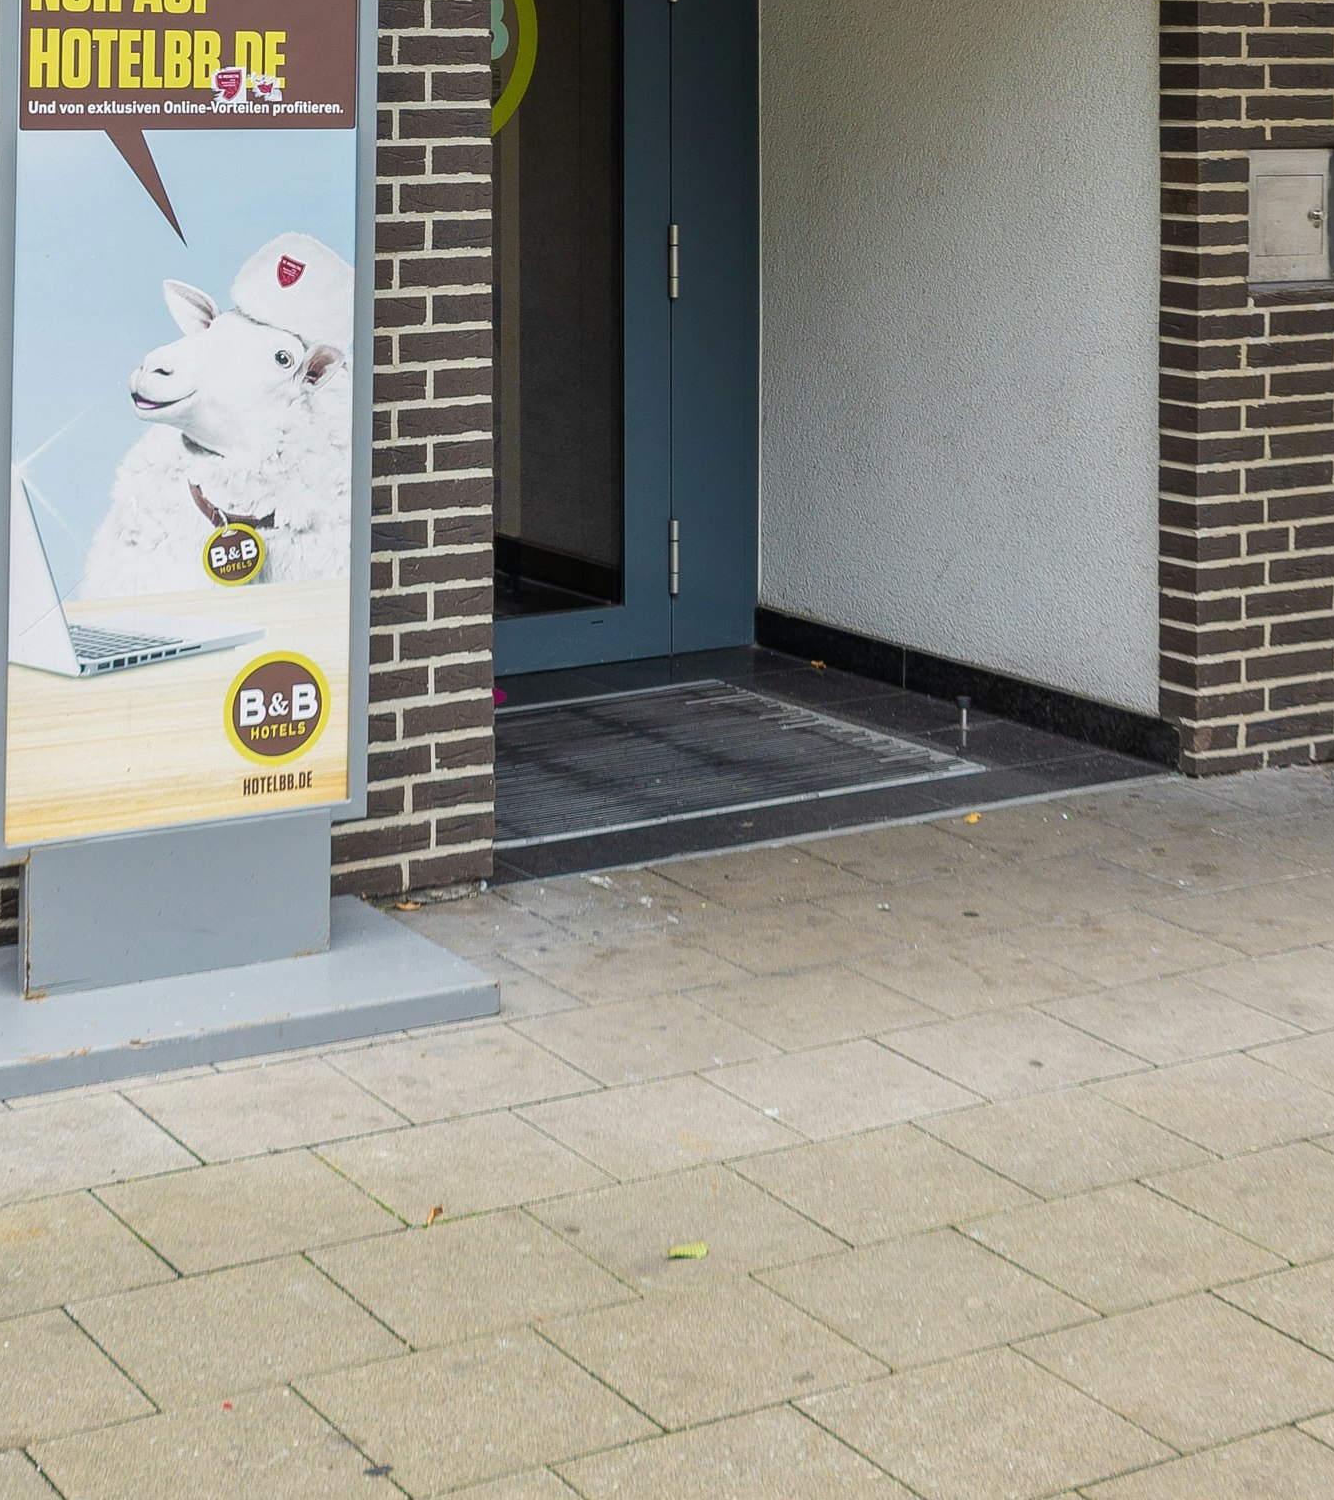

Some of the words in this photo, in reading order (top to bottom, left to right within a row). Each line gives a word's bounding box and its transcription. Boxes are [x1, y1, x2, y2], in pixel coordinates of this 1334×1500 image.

[28, 27, 287, 89] HOTELBBDE
[28, 100, 56, 115] Und
[59, 103, 85, 115] von
[87, 100, 161, 115] exklusiven
[163, 100, 270, 116] Online-Vorteilen
[272, 100, 345, 118] profitieren.
[210, 537, 259, 568] B&B
[219, 558, 254, 575] HOTELS
[238, 681, 319, 728] B&B
[249, 721, 307, 741] HOTELS
[242, 770, 313, 796] HOTELBB.DE
